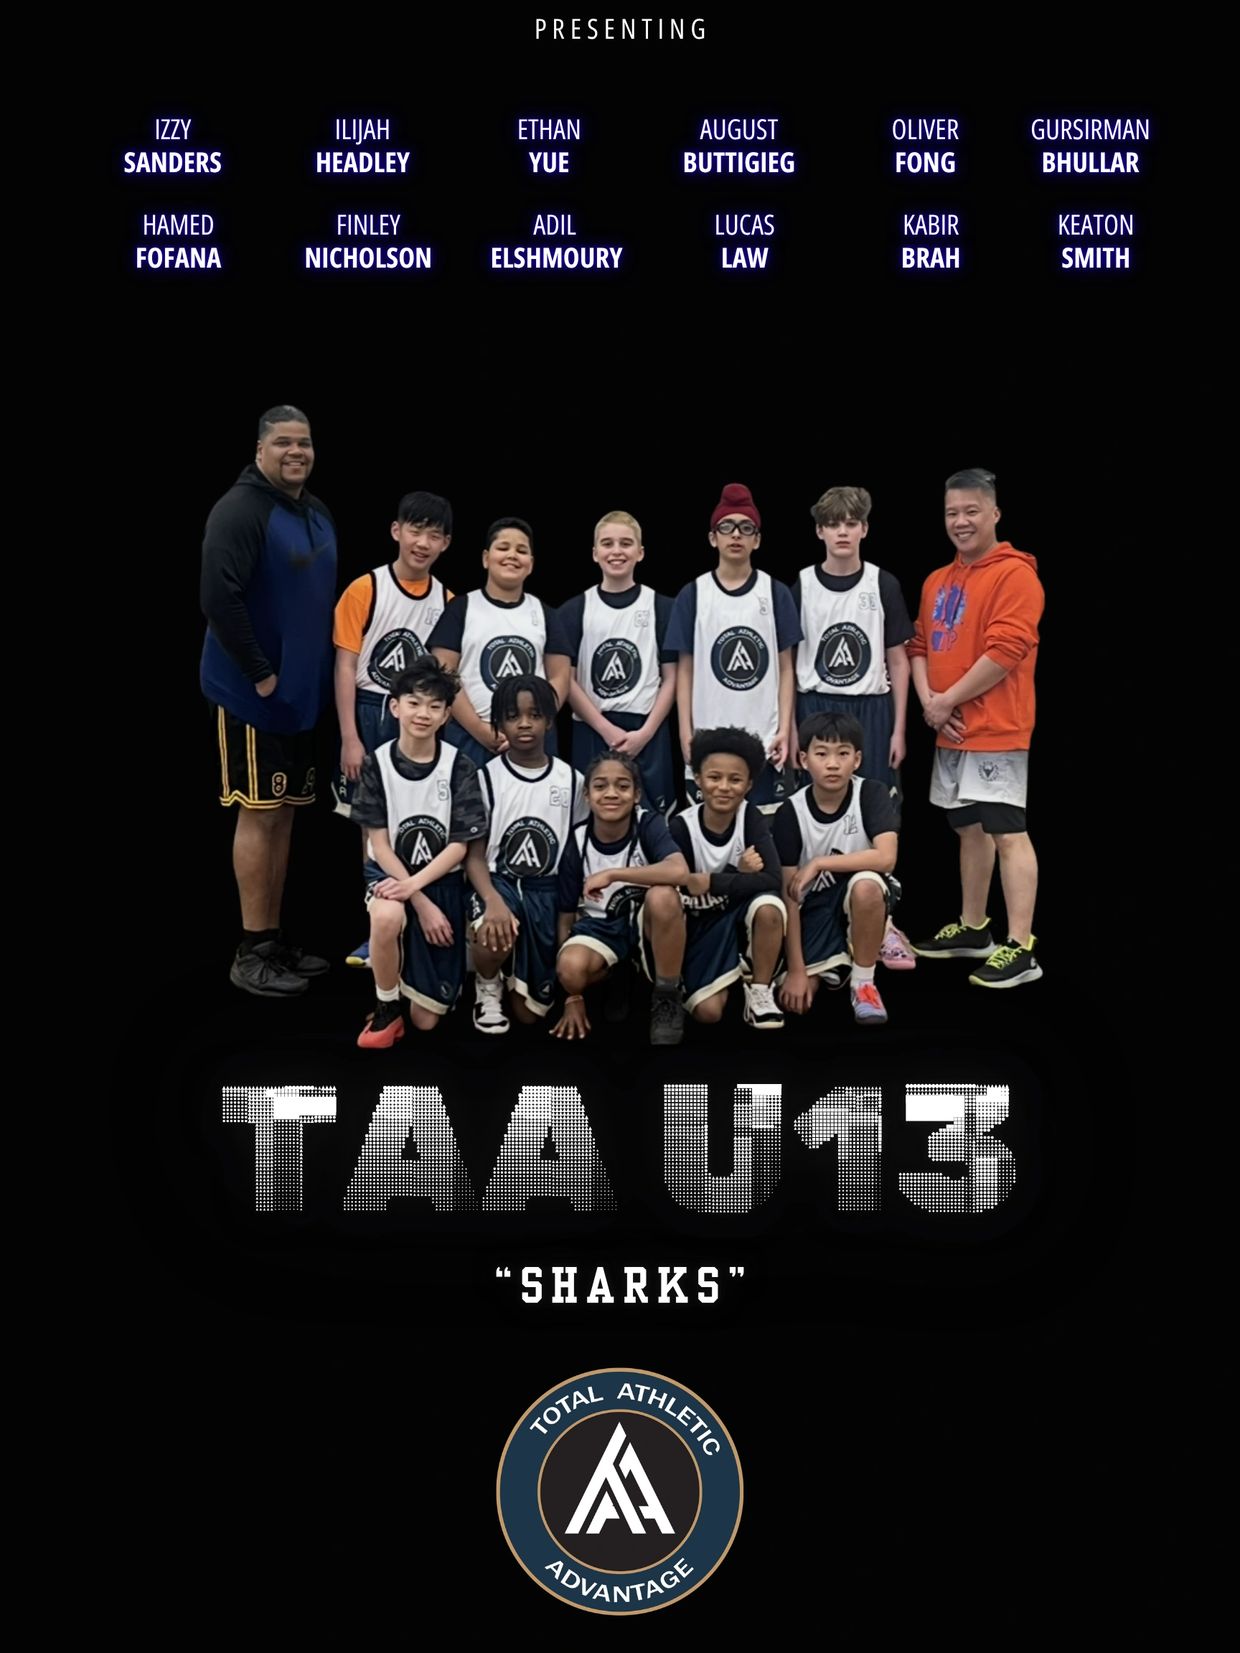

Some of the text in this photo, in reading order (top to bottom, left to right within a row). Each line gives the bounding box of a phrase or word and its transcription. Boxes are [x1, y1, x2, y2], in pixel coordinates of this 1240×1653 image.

[716, 628, 765, 650] TOTAL ATHLETIC
[821, 624, 868, 646] TOTAL ATHLETIC
[487, 637, 535, 659] TOTAL ATHLETIC
[722, 676, 760, 690] ADVANTAGE
[271, 771, 288, 797] 8
[437, 779, 449, 802] 5
[399, 820, 416, 835] OTAL
[505, 820, 557, 846] TOTAL ATHLETIC
